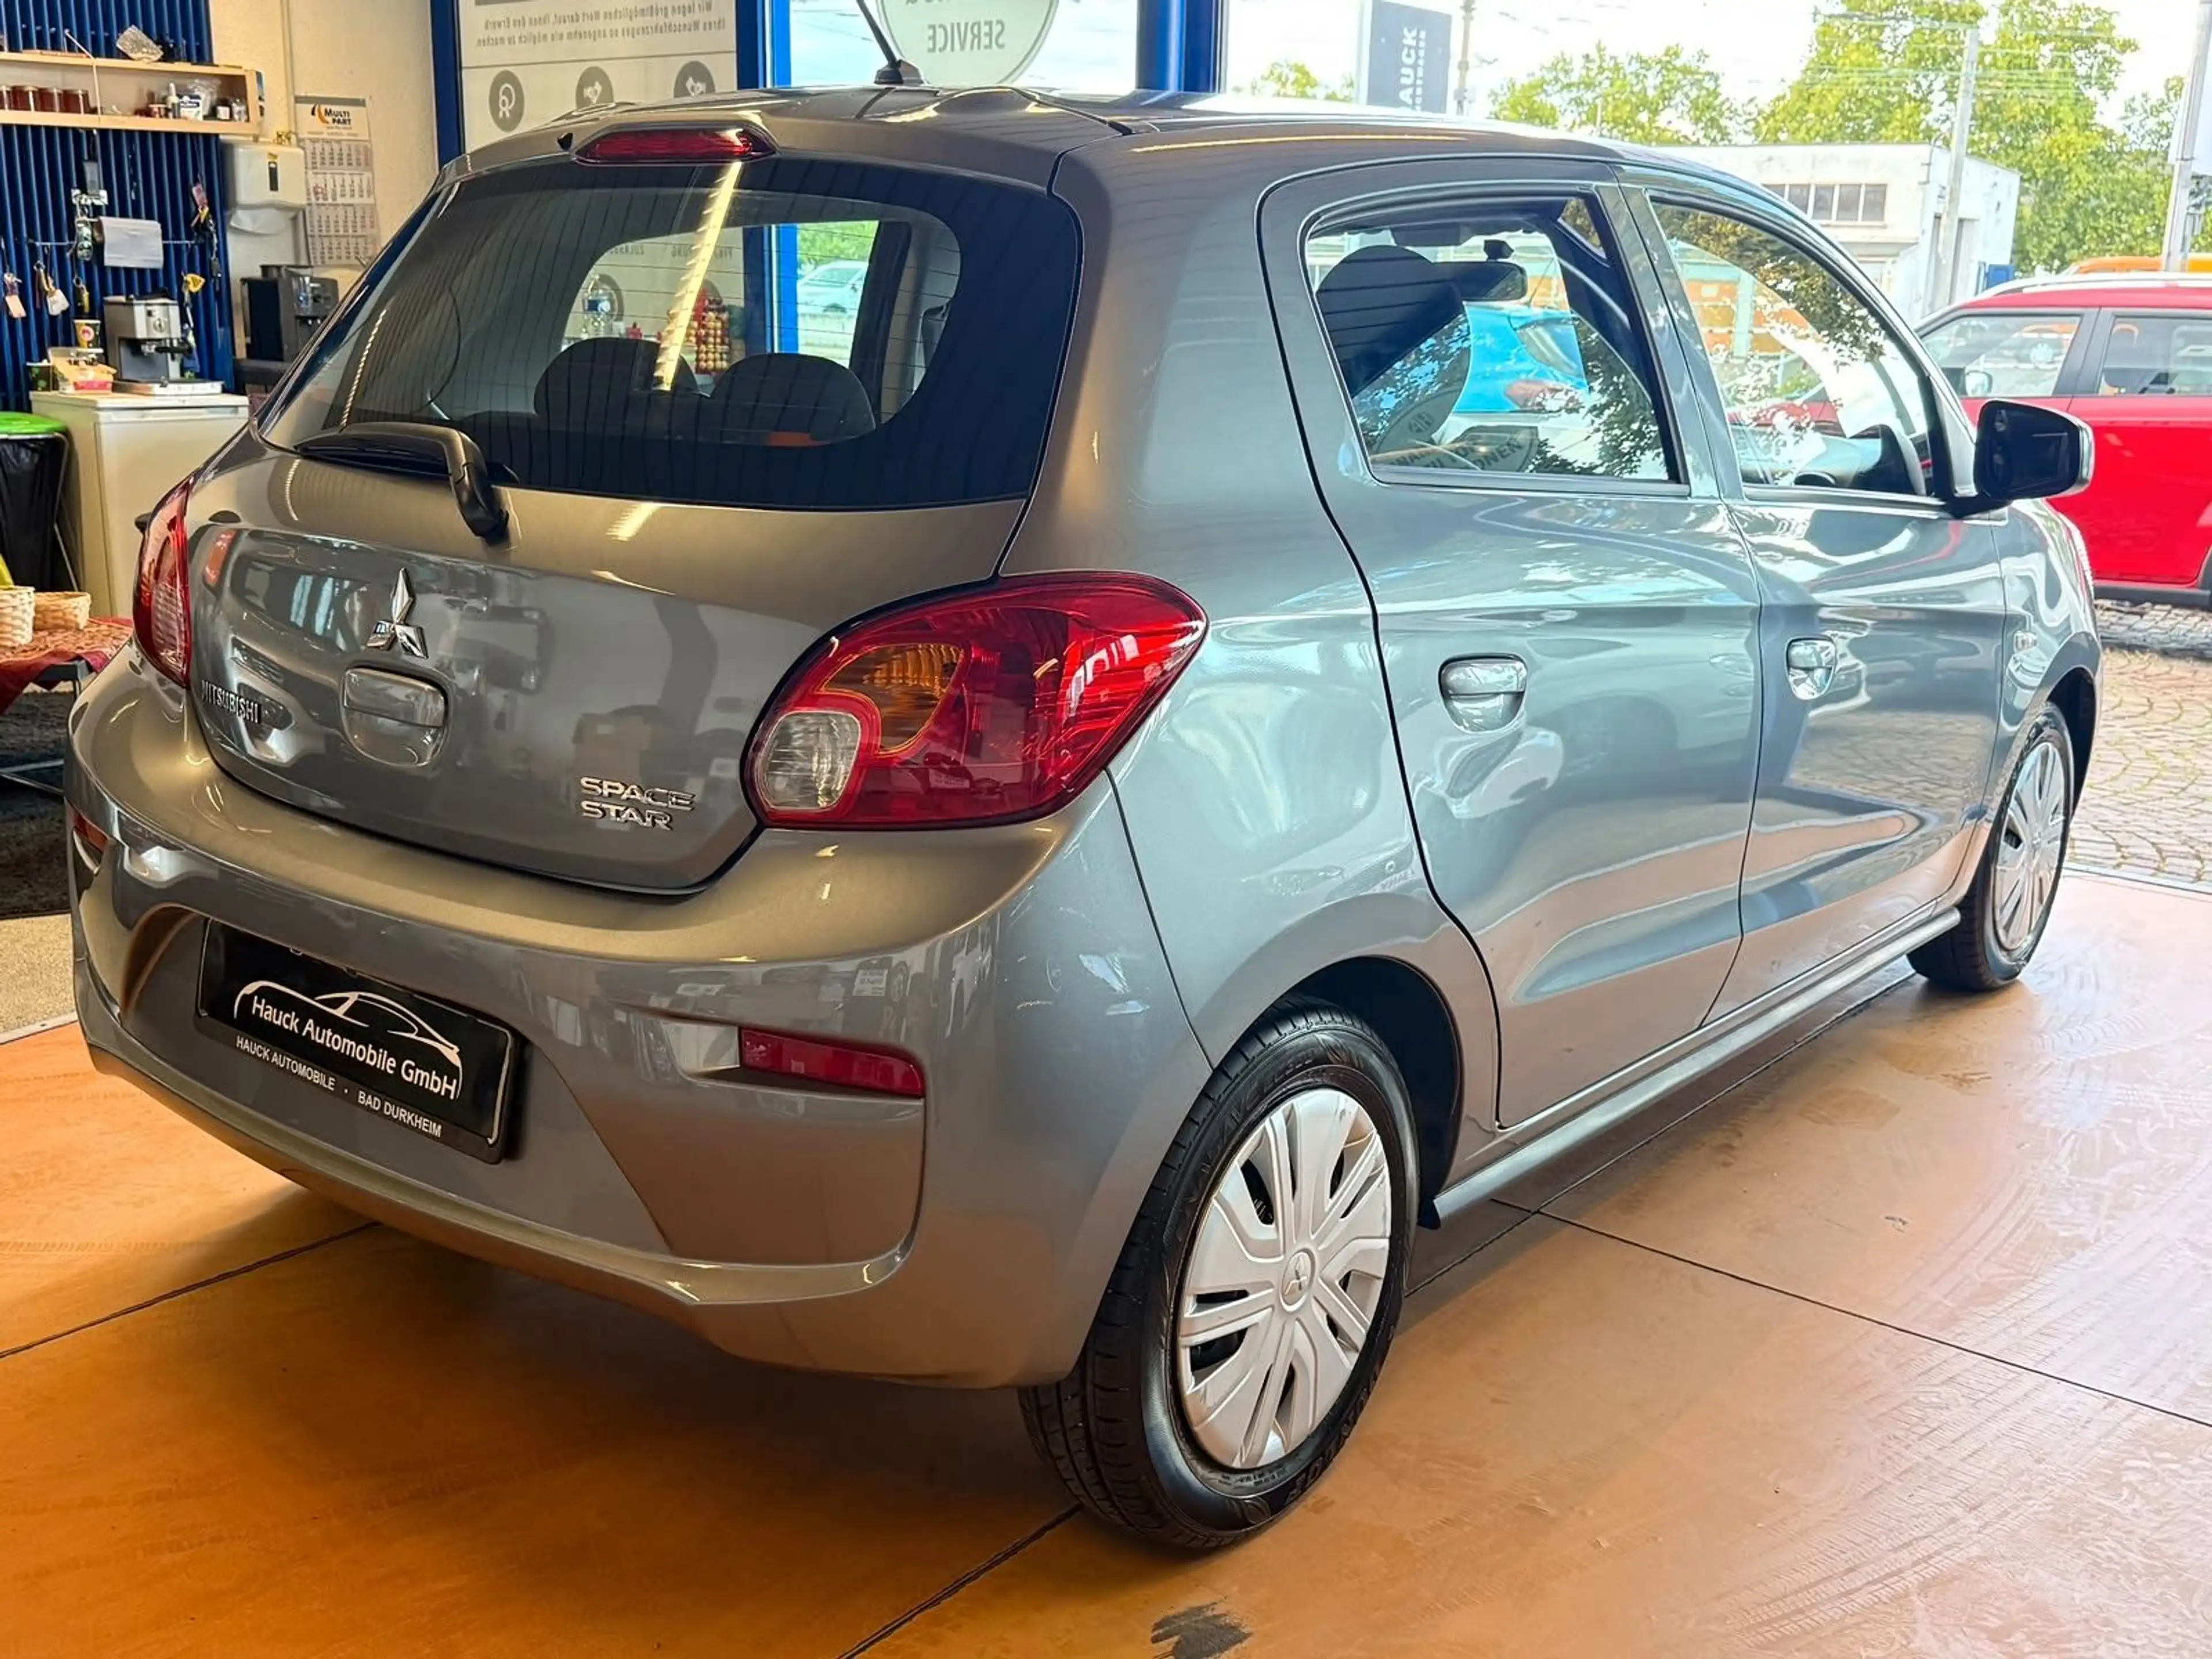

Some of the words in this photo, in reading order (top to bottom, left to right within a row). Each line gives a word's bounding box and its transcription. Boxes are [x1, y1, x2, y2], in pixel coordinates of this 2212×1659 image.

[332, 118, 351, 126] PART
[201, 680, 259, 724] MITSUBISHI
[580, 776, 696, 812] SPACE
[581, 799, 673, 831] STAR
[252, 995, 300, 1034] Hauck
[301, 1018, 397, 1074] Automobile
[401, 1059, 457, 1100] GmbH
[236, 1035, 271, 1061] HAUCK
[271, 1052, 336, 1091] AUTOMOBILE
[358, 1090, 381, 1111] BAD
[383, 1100, 442, 1138] DURKHEIM
